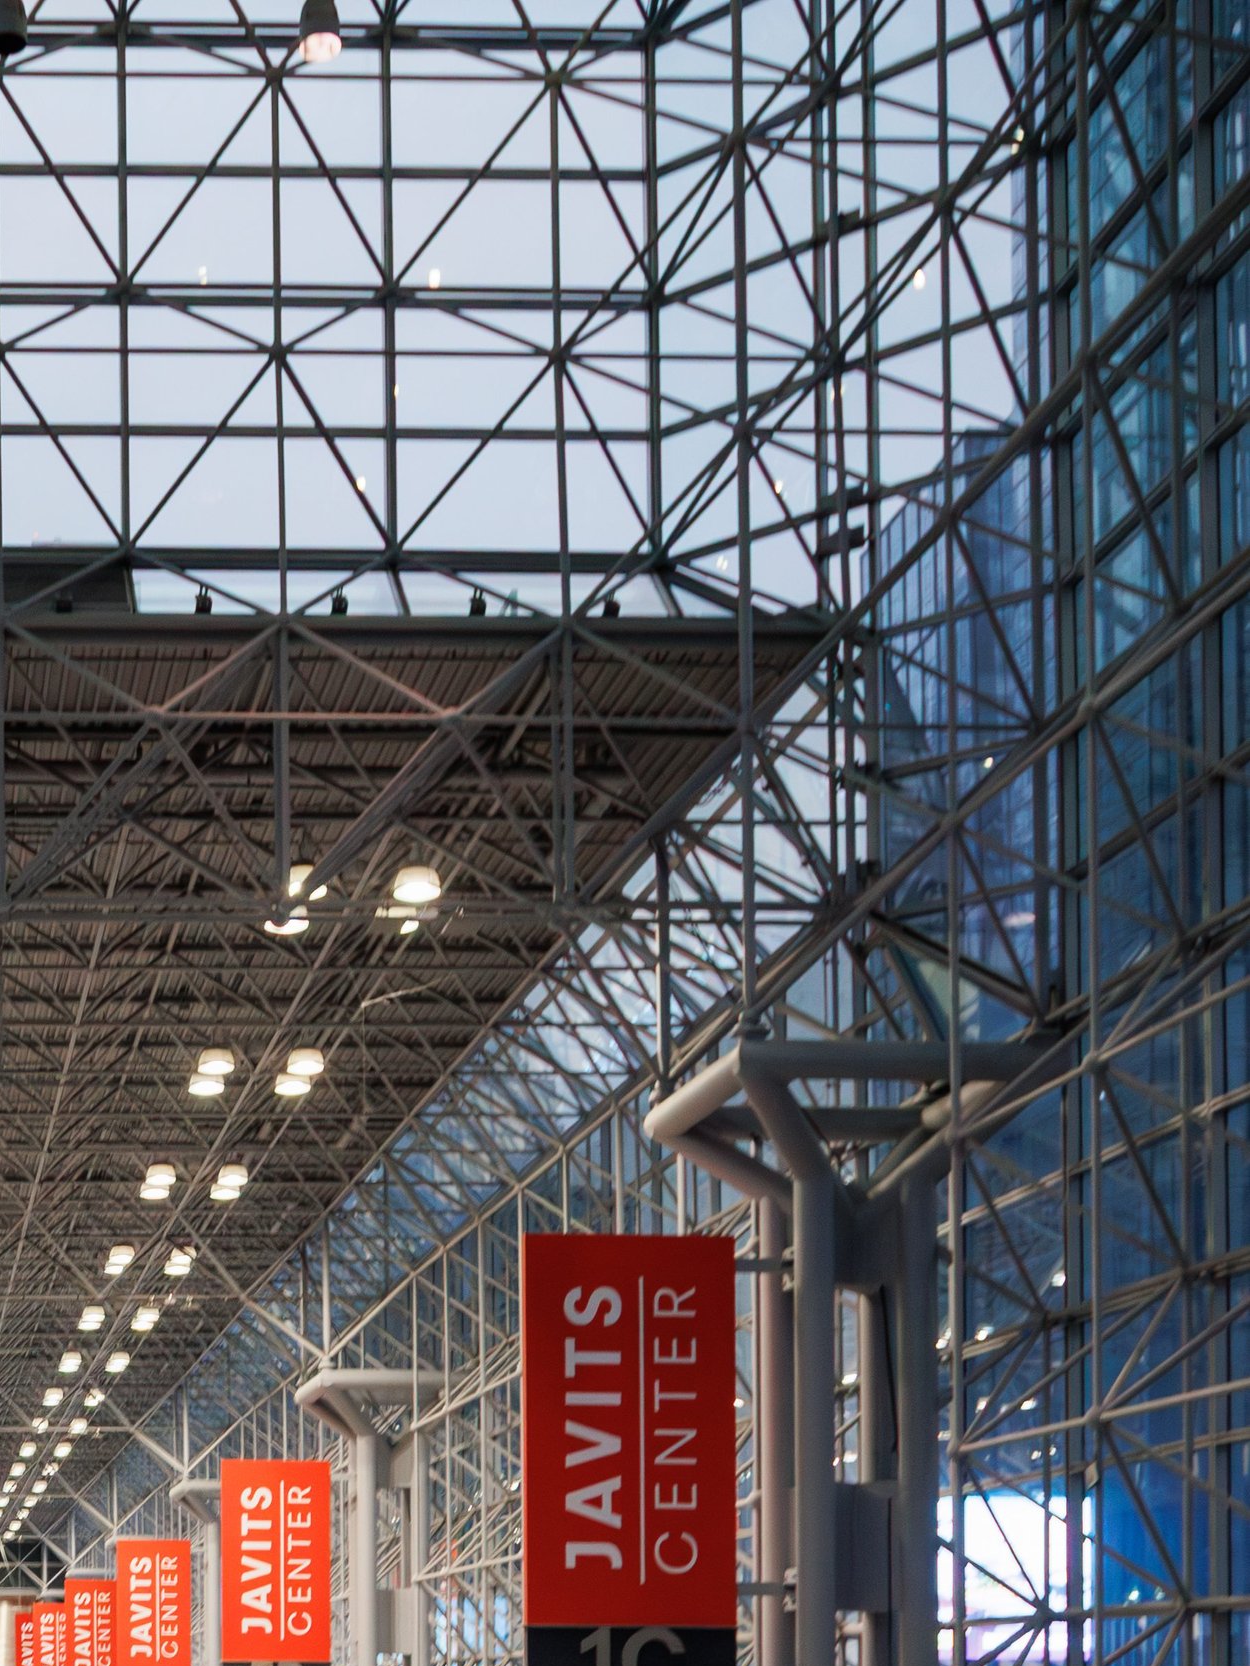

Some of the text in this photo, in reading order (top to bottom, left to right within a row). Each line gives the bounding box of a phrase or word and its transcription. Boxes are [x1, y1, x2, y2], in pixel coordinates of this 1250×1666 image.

[563, 1285, 622, 1570] JAVITS
[653, 1286, 698, 1575] CENTER
[129, 1556, 153, 1658] JAVITS
[161, 1556, 179, 1659] CENTER
[241, 1486, 273, 1635] JAVITS
[287, 1485, 312, 1636] CENTER
